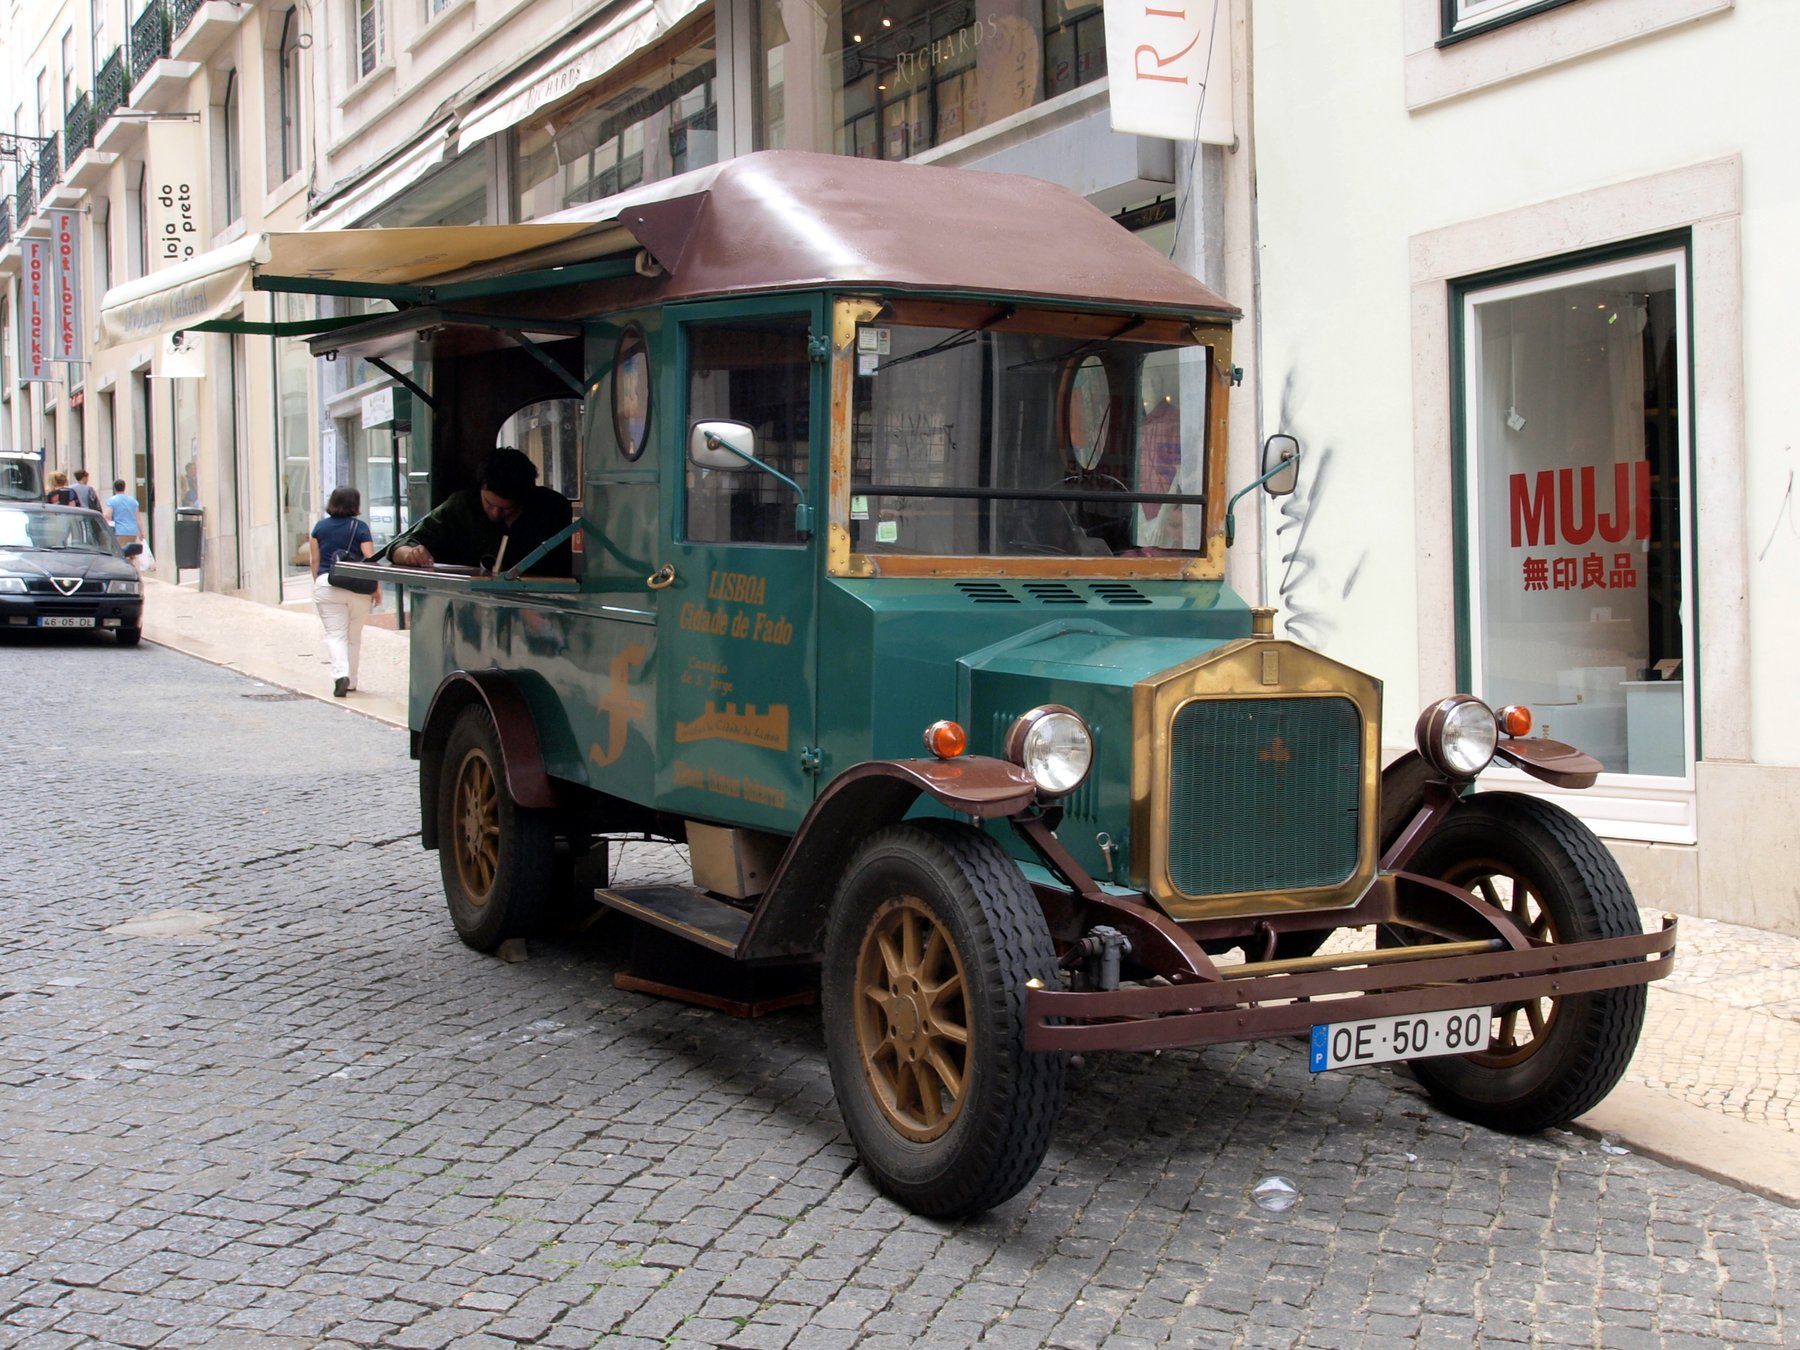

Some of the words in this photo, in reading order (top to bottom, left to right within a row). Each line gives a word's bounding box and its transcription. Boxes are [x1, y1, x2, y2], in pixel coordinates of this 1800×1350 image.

[158, 185, 173, 208] do
[178, 184, 196, 232] preto
[162, 223, 181, 258] loja
[1509, 460, 1651, 548] MUJI
[708, 570, 765, 605] LISBOA
[1523, 552, 1637, 592] 無印良品
[680, 601, 728, 636] Cidade
[731, 609, 750, 639] de
[753, 612, 793, 647] Fado
[1315, 1053, 1324, 1064] P
